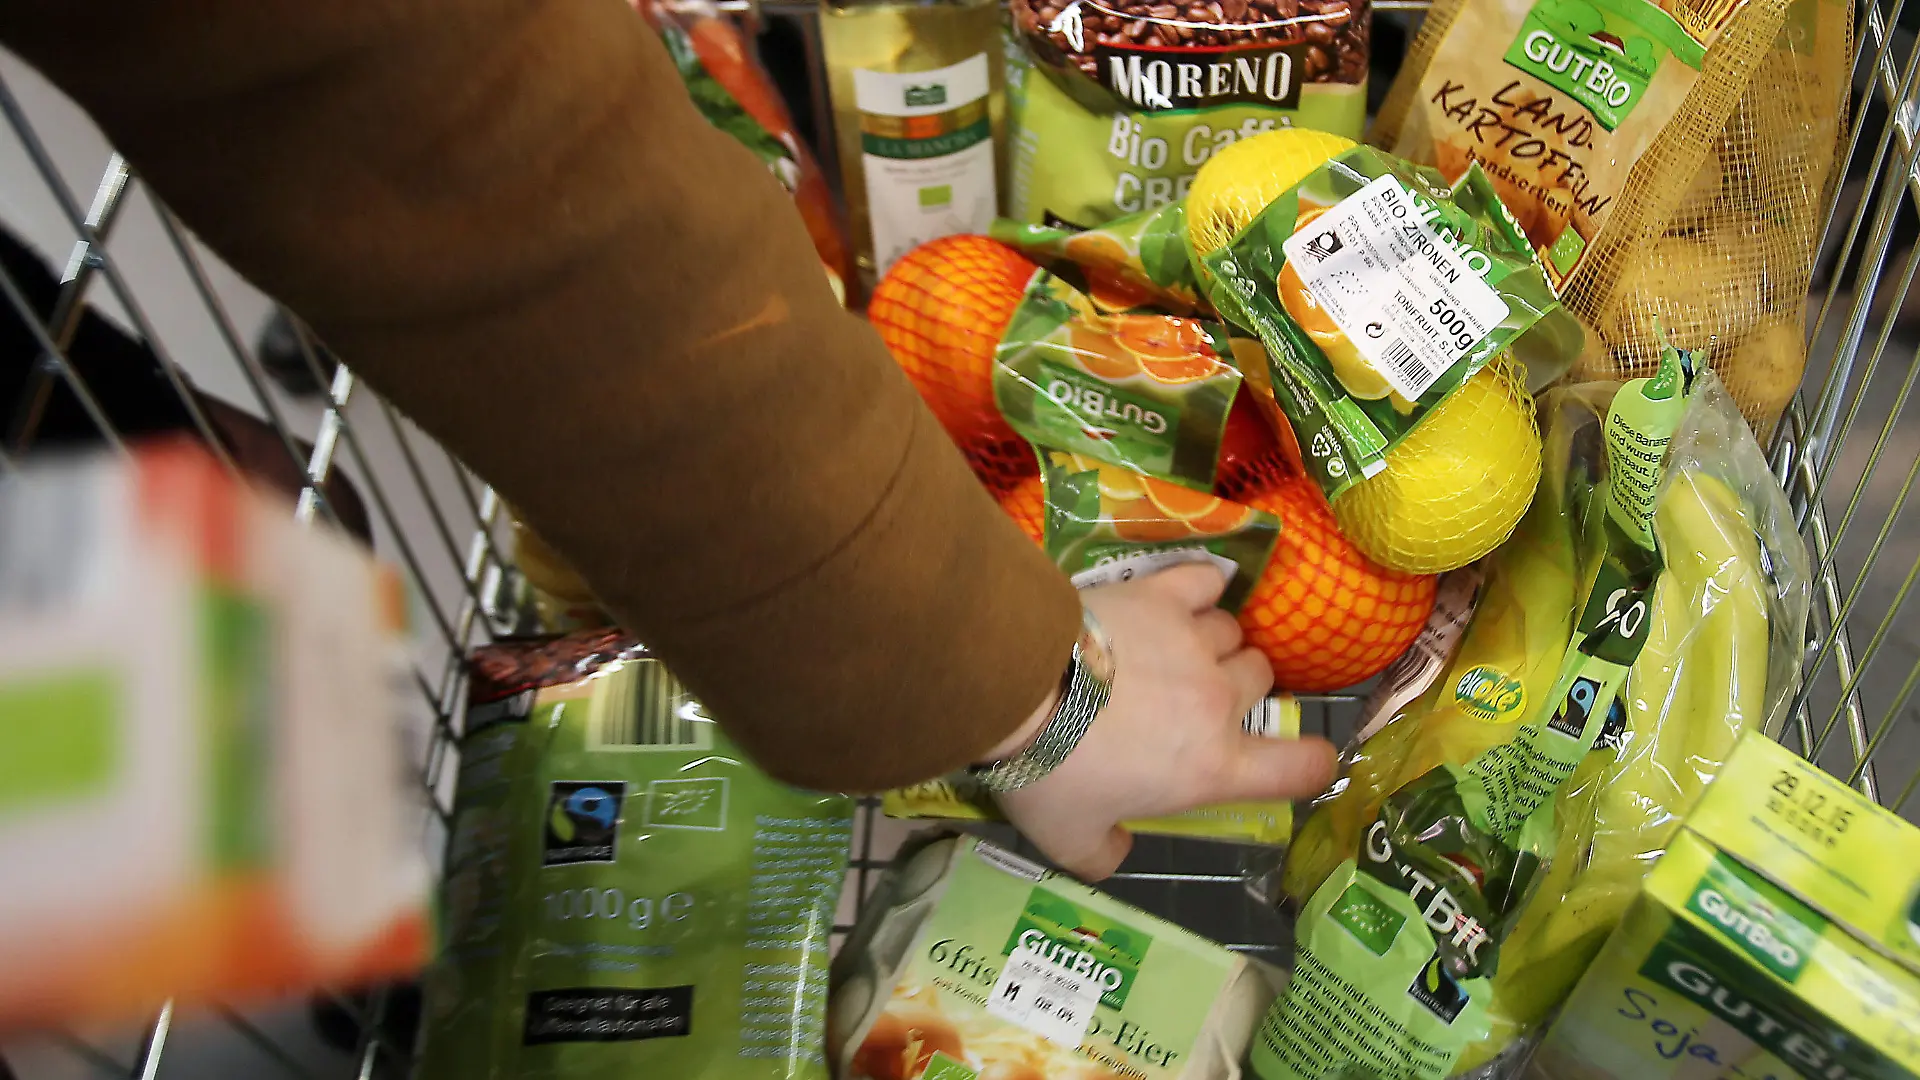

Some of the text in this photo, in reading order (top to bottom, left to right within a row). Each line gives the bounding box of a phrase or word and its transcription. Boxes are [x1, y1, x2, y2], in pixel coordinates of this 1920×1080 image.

[1109, 51, 1292, 109] MORENO
[1108, 113, 1169, 169] Bio
[1466, 146, 1568, 217] handsortiert
[1380, 186, 1461, 284] BIO-ZIRONEN
[1427, 297, 1478, 353] 500g
[1609, 428, 1625, 446] und
[1613, 414, 1635, 437] Diese
[928, 938, 956, 965] 6
